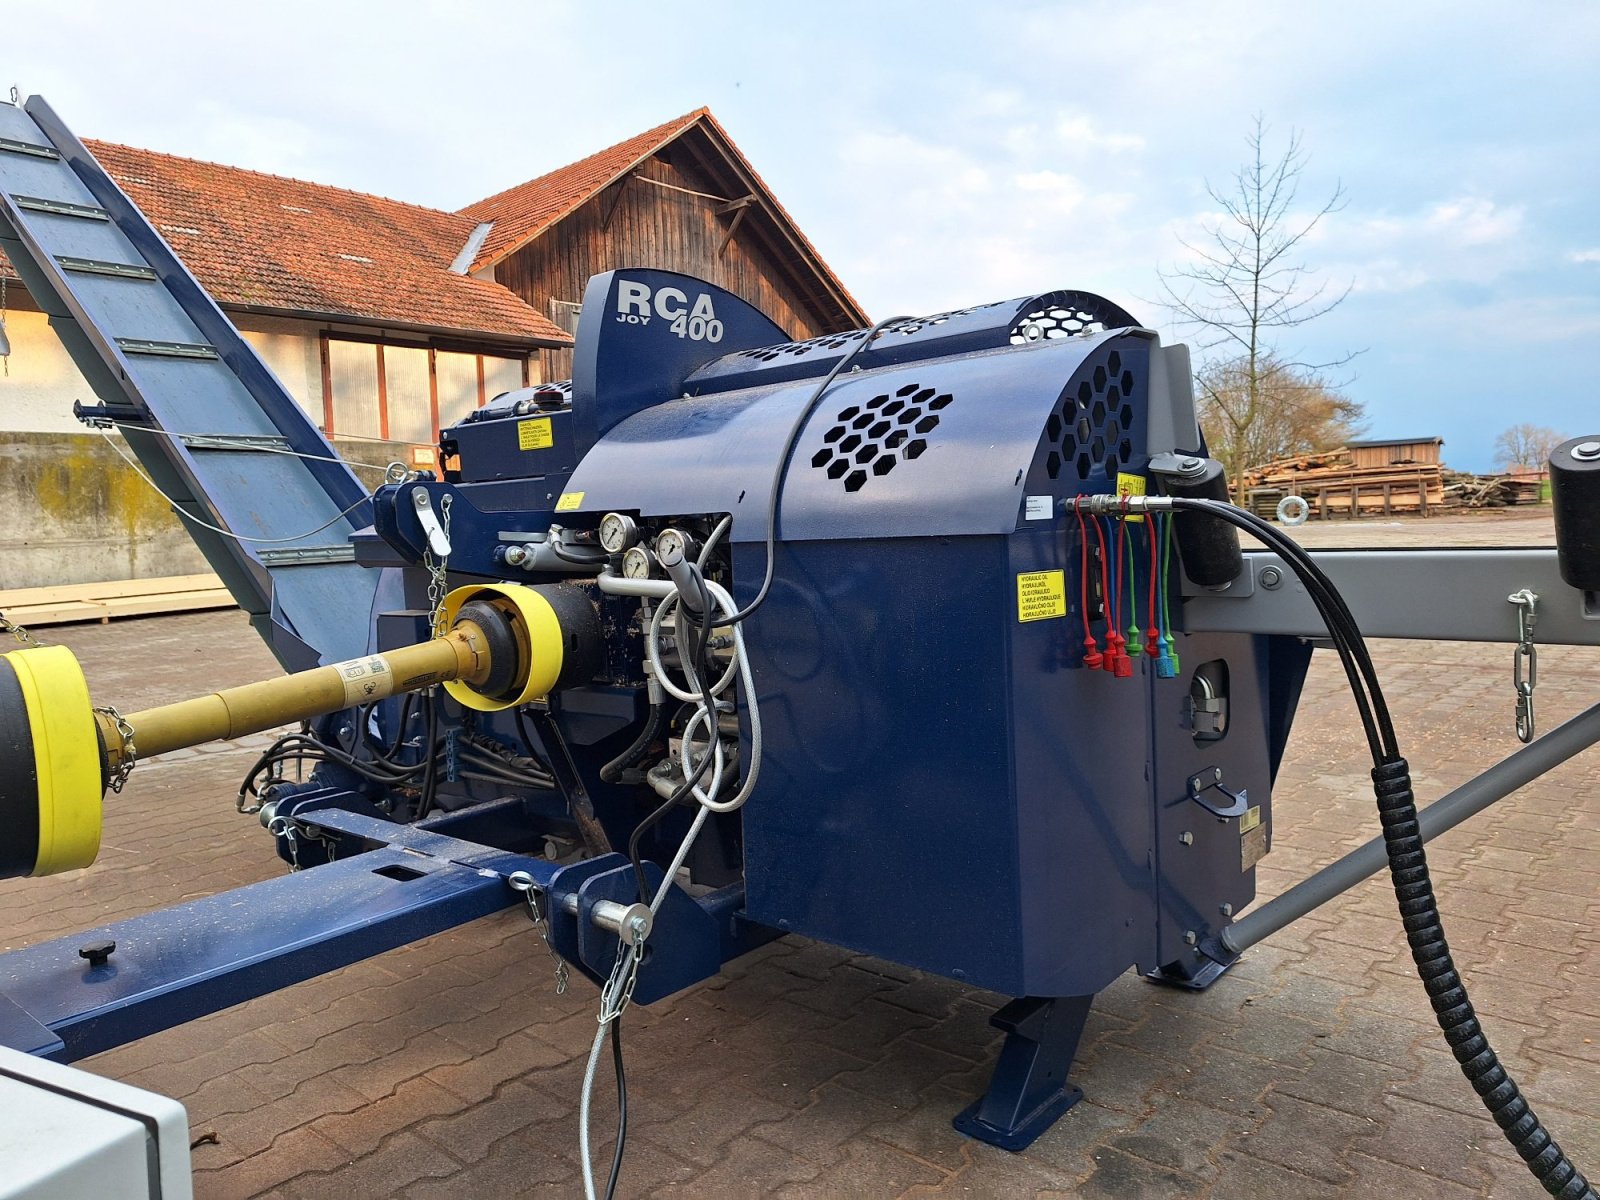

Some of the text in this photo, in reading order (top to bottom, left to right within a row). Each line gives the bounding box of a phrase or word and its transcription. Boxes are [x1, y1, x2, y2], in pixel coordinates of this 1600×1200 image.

[617, 279, 716, 322] RCA
[616, 314, 651, 326] JOY
[669, 315, 724, 343] 400
